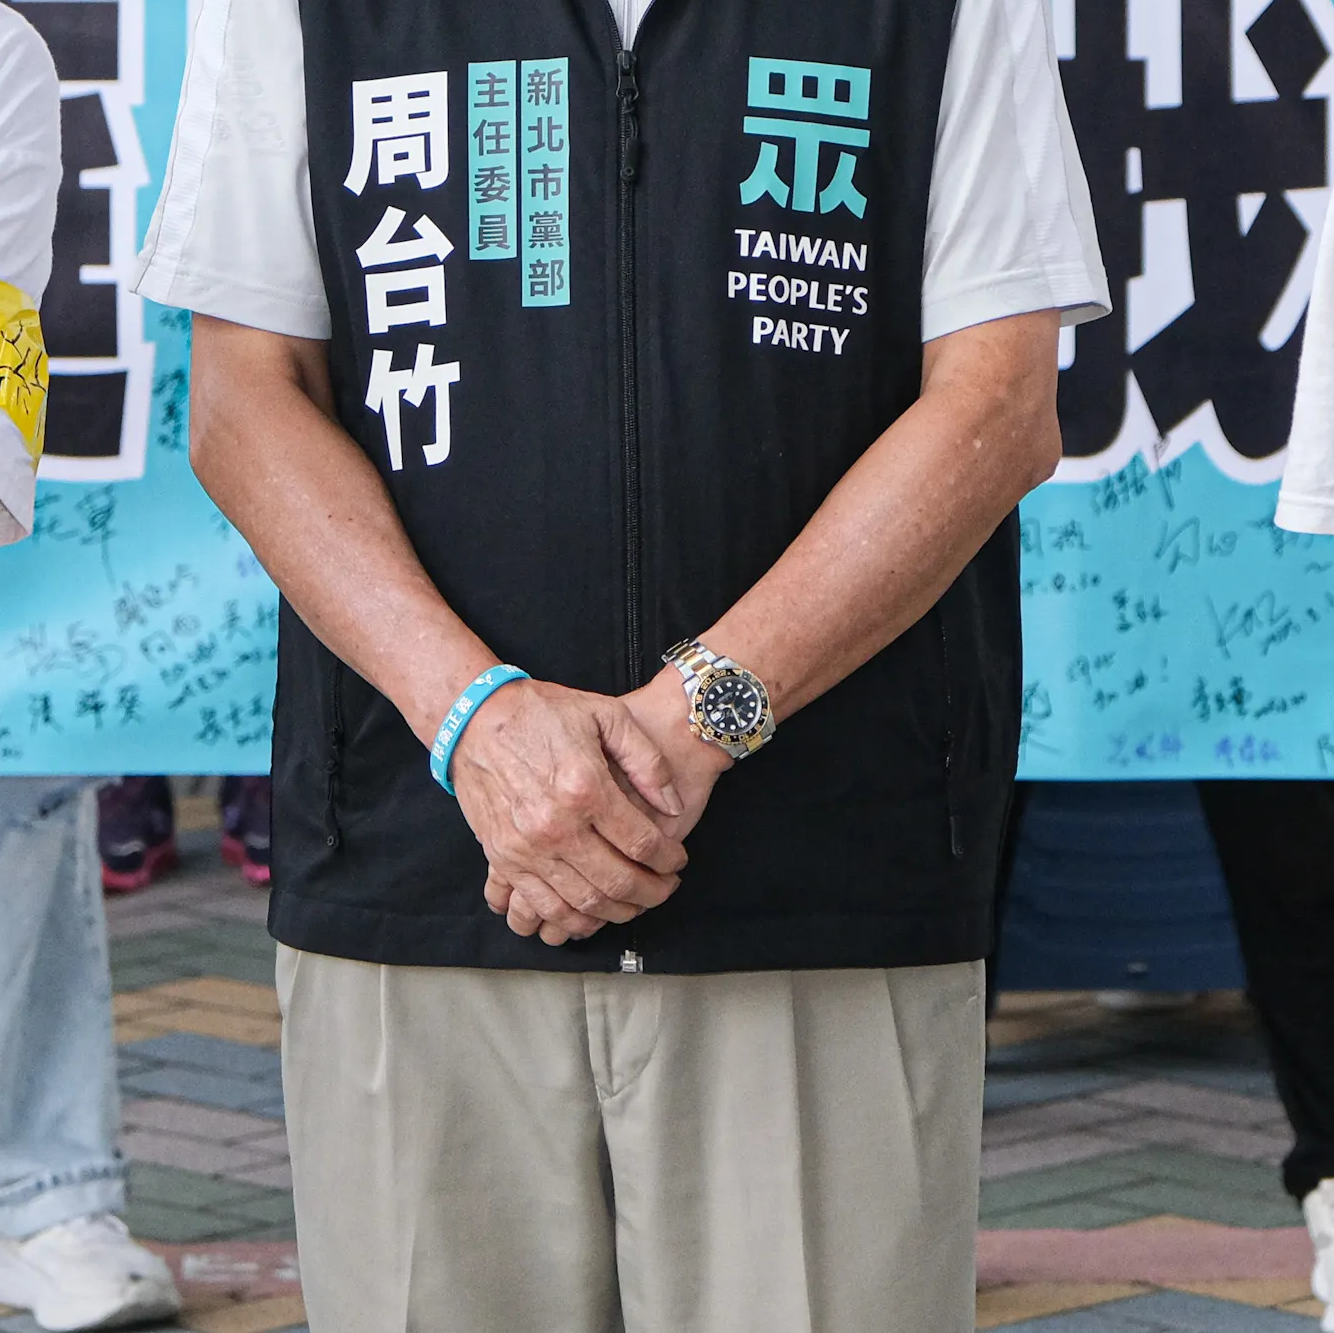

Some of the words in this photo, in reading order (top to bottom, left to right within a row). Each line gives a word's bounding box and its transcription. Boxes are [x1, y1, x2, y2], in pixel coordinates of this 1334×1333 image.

[473, 73, 511, 253] 主任委員
[526, 69, 566, 298] 新北市黨部
[343, 70, 462, 472] 周台竹
[728, 270, 869, 316] PEOPLE'S
[734, 229, 868, 272] TAIWAN
[752, 315, 851, 356] PARTY
